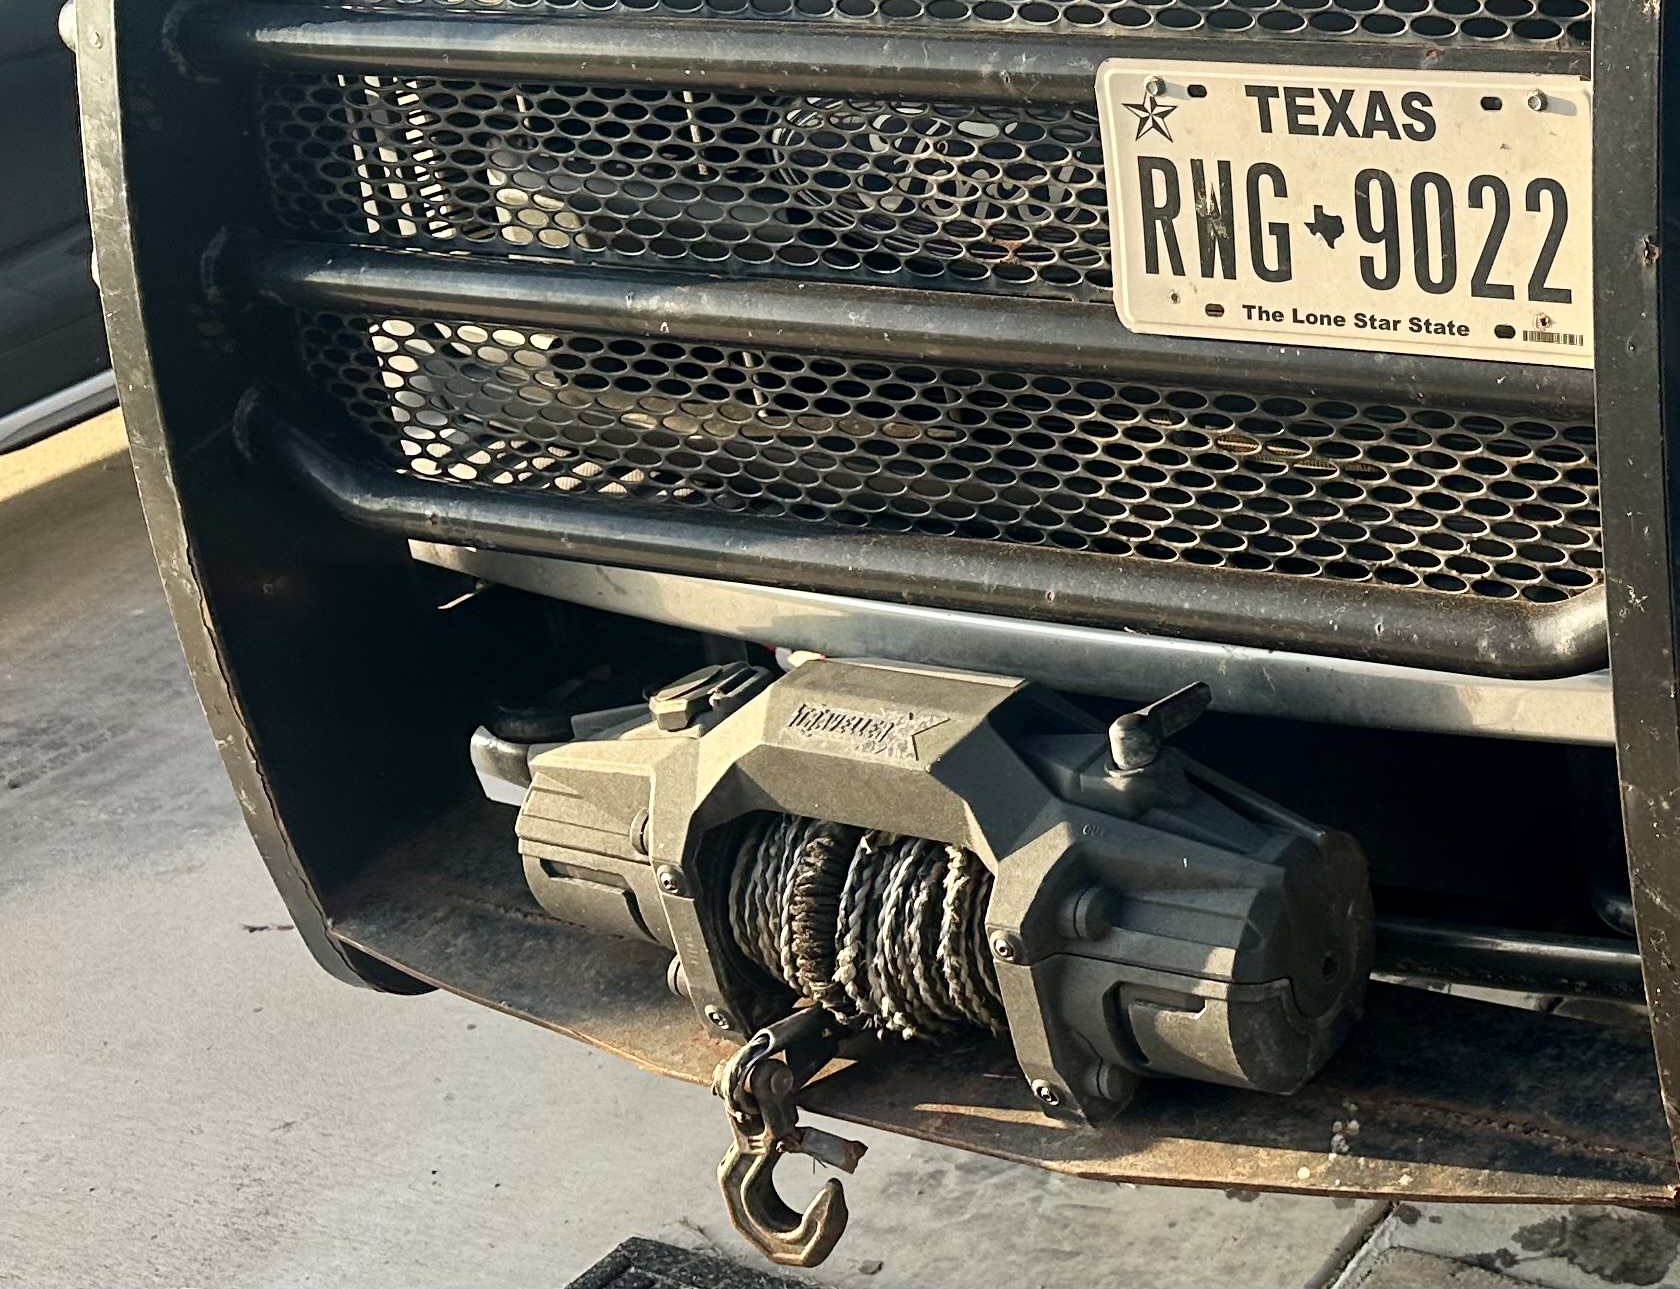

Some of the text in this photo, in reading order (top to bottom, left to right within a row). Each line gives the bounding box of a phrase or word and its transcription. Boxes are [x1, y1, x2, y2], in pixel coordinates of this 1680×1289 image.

[1246, 84, 1437, 142] TEXAS
[1354, 168, 1573, 305] 9022
[1242, 304, 1471, 337] The Lone Star State
